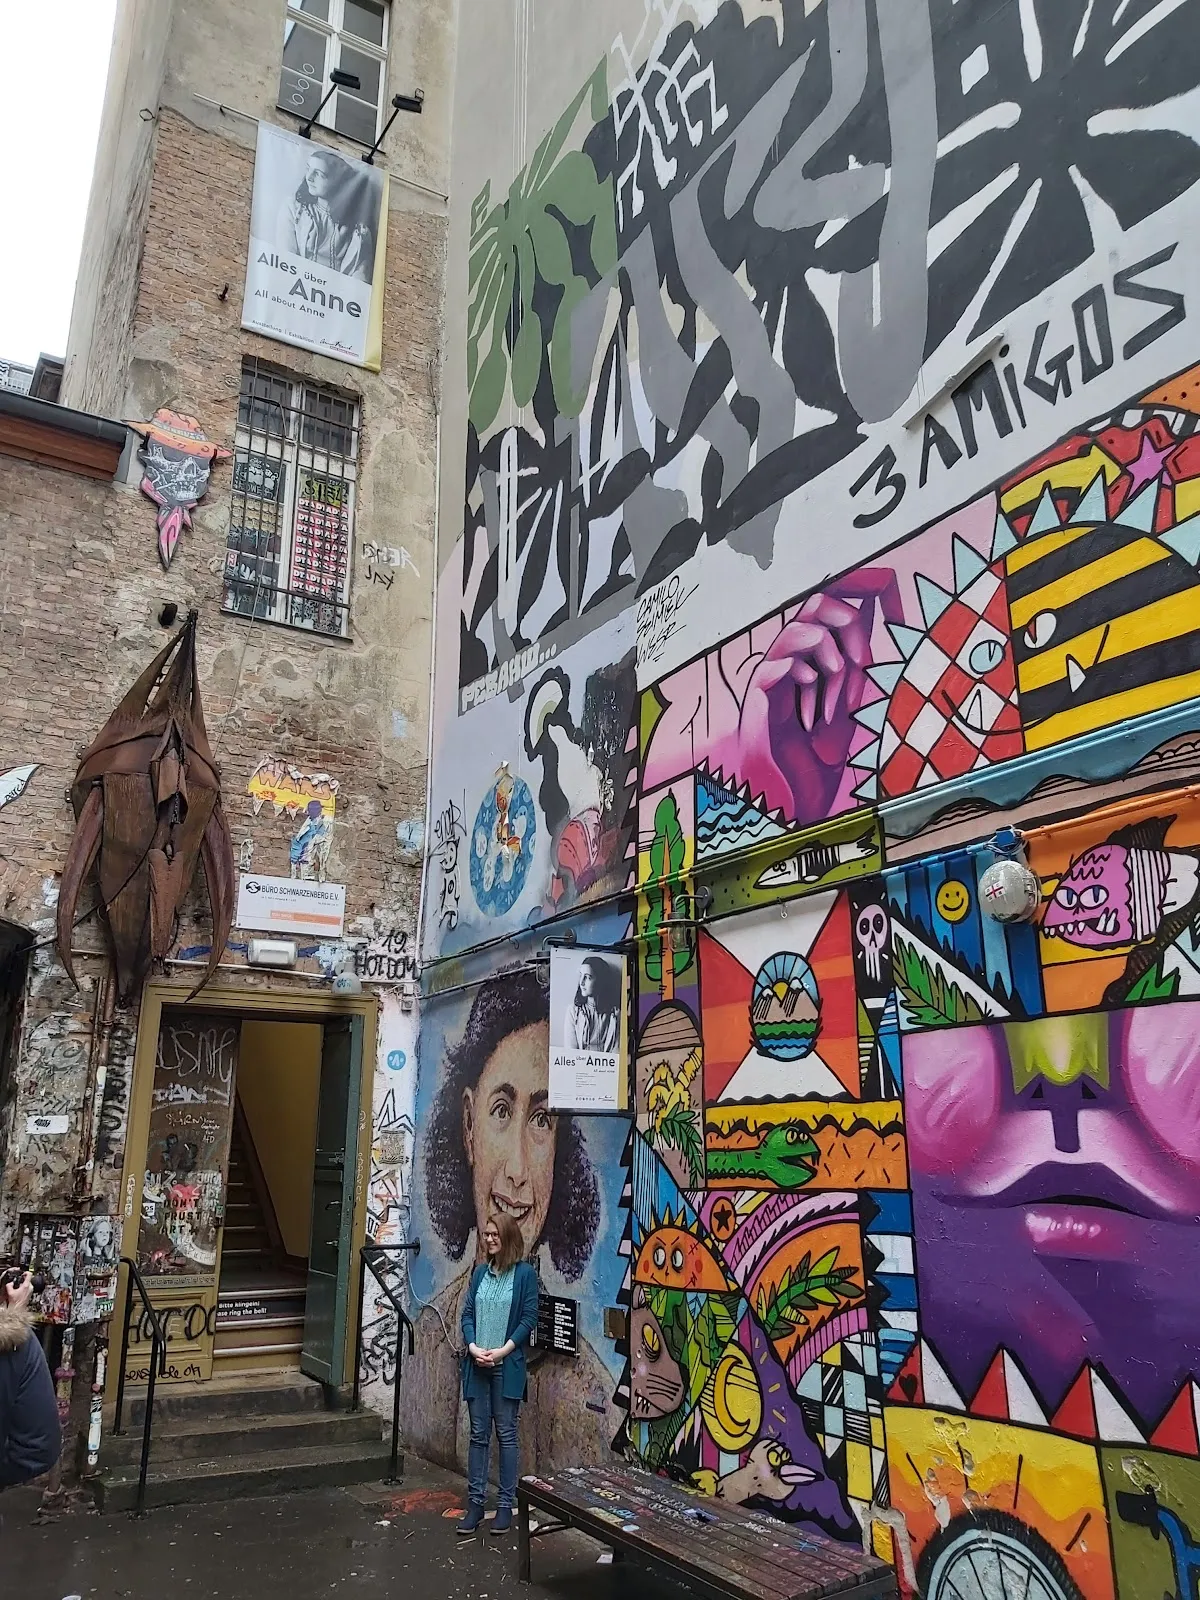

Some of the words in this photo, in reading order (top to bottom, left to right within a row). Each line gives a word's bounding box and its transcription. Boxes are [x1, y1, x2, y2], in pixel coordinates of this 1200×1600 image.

[257, 252, 297, 276] Alles
[304, 271, 327, 286] über
[254, 289, 269, 299] All
[271, 294, 296, 309] about
[299, 304, 325, 319] Anne
[288, 278, 362, 318] Anne
[849, 444, 906, 528] 3
[262, 885, 278, 893] BÜRO
[279, 887, 328, 900] SCHWARZENBERG
[554, 1056, 575, 1066] Alles
[586, 1055, 615, 1067] Anne
